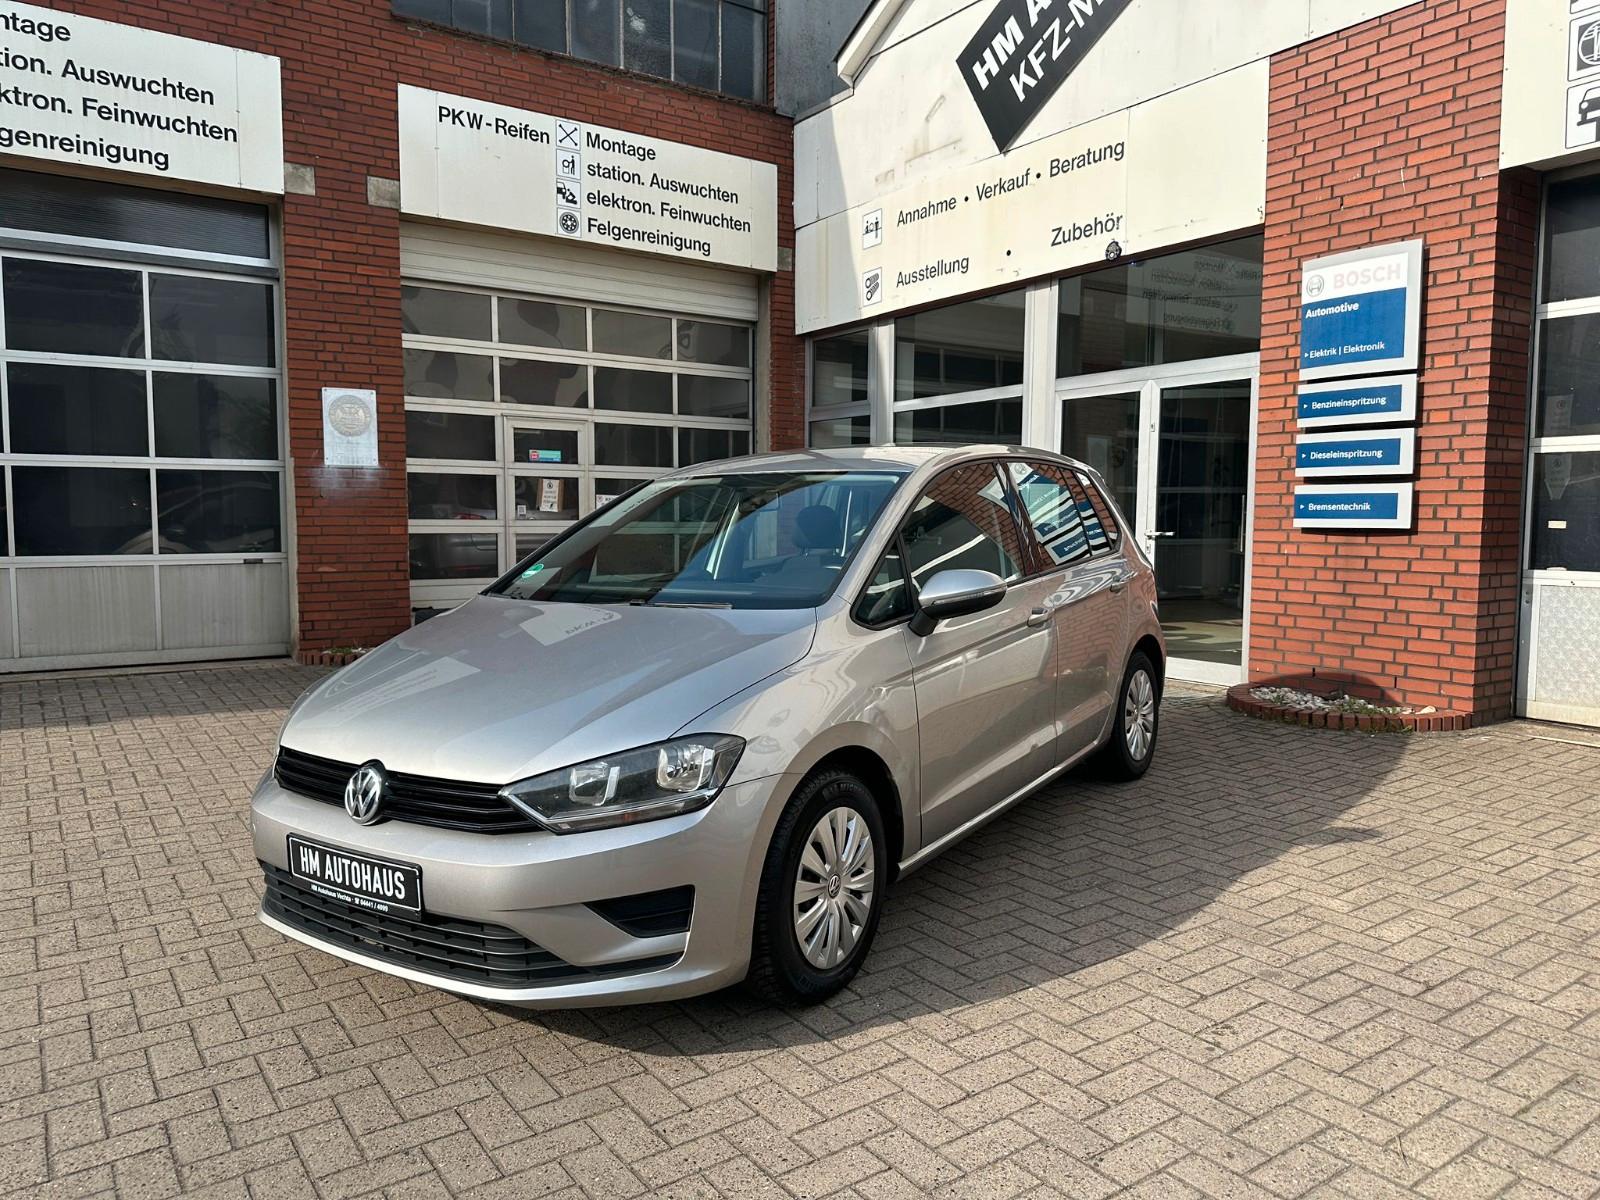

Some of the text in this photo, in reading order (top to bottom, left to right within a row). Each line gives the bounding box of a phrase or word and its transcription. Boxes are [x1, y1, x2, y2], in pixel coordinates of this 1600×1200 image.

[972, 15, 1024, 91] HM
[61, 58, 214, 105] Auswuchten
[0, 82, 238, 142] ktron. Feinwuchten
[438, 106, 550, 145] PKW-Reifen
[0, 127, 169, 171] genreinigung
[586, 132, 656, 160] Montage
[587, 162, 738, 204] station. Auswuchten
[897, 141, 1125, 227] Annahme Verkauf Beratung
[587, 190, 751, 233] elektron. Feinwuchten
[587, 218, 711, 256] Felgenreinigung
[896, 212, 1123, 288] Ausstellung Zubehör
[1333, 263, 1401, 289] BOSCH
[1305, 301, 1360, 319] Automotive
[1309, 346, 1337, 359] Elektrik
[1343, 341, 1385, 354] Elektronik
[1311, 396, 1387, 410] Benzineinspritzung
[1310, 449, 1383, 460] Dieseleinspritzung
[1308, 502, 1371, 511] Bremsentechnik
[299, 845, 406, 900] HM AUTOHAUS
